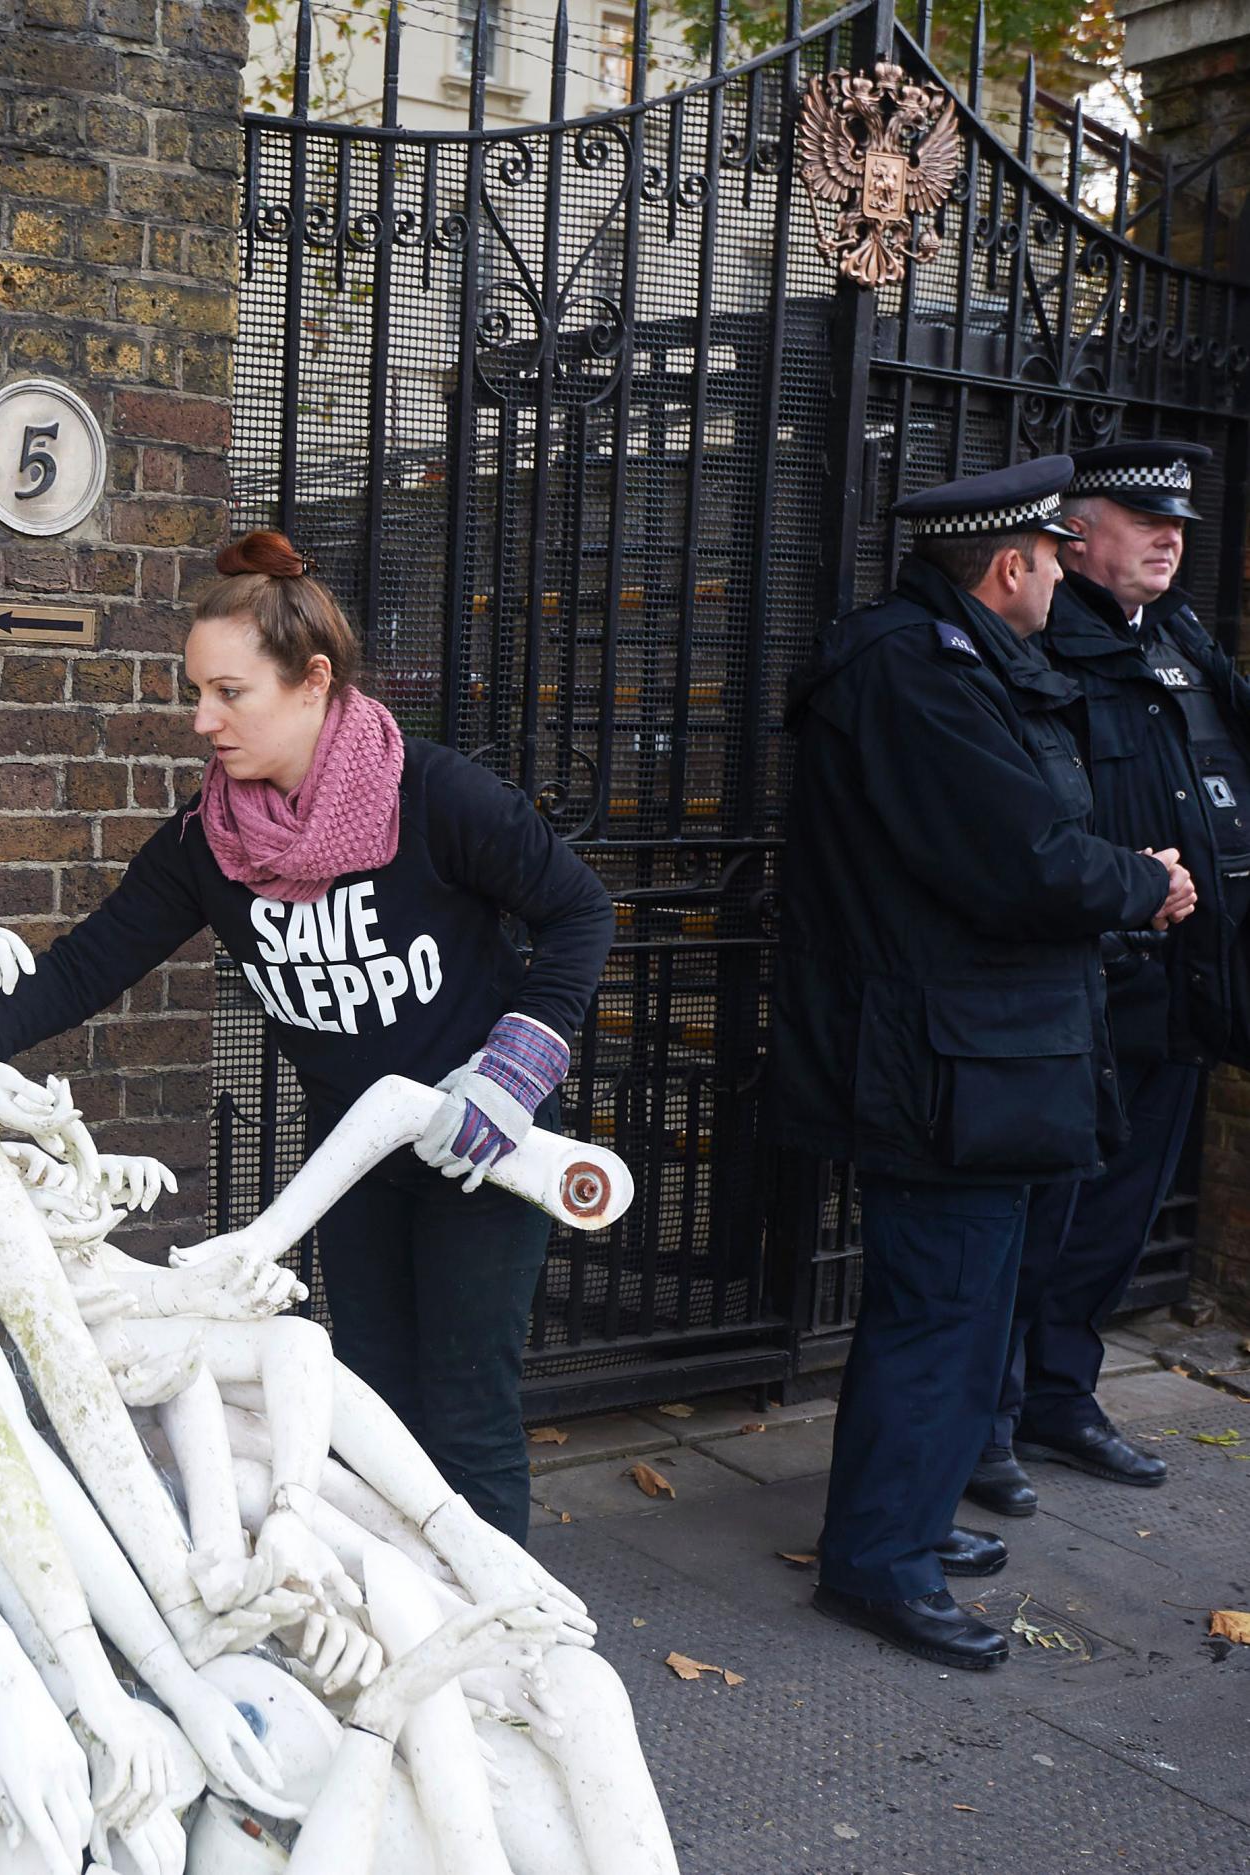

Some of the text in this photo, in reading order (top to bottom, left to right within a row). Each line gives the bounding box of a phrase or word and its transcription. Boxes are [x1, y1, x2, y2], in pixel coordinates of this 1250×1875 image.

[14, 421, 60, 501] 5
[1153, 667, 1189, 686] OLICE
[249, 880, 388, 964] SAVE
[241, 933, 443, 1035] ALEPPO
